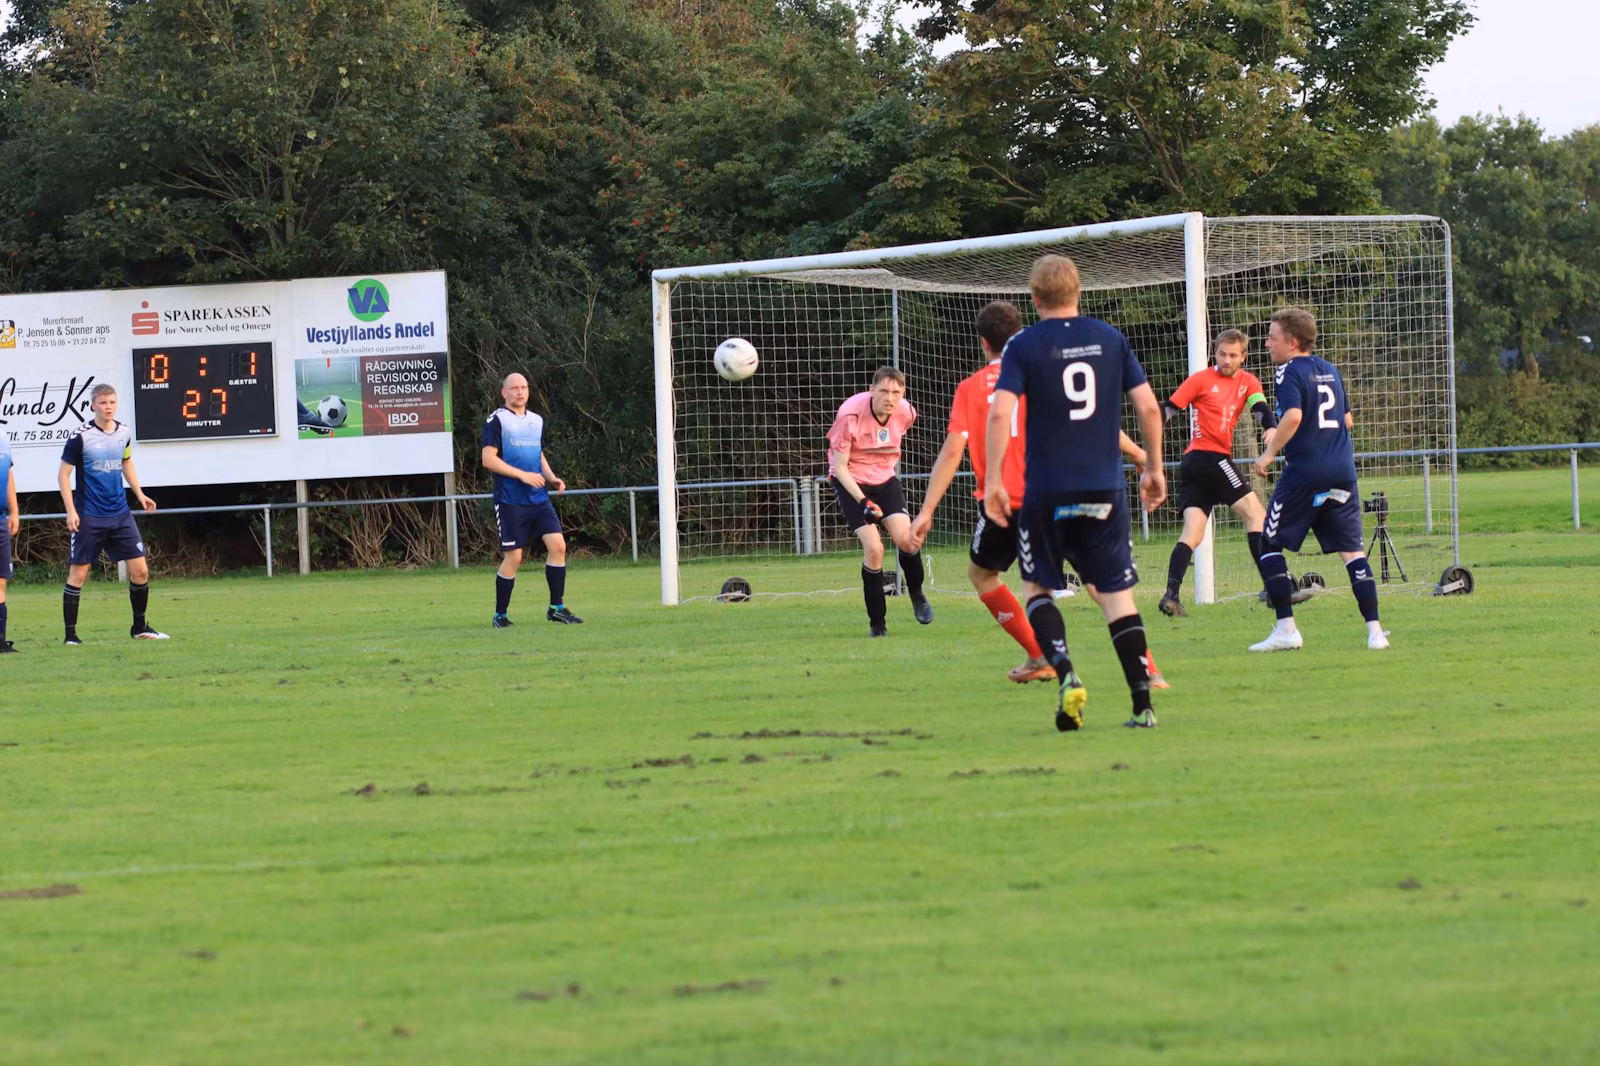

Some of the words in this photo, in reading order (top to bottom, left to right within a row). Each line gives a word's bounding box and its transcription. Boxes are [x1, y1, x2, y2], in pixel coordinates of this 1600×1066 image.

[347, 286, 390, 314] VA
[164, 305, 272, 322] SPAREKASSEN
[42, 316, 84, 325] Murerfirmaet
[18, 328, 24, 338] P.
[26, 328, 55, 337] Jensen
[56, 327, 63, 336] &
[65, 326, 93, 335] Sønner
[96, 325, 110, 336] aps
[165, 327, 177, 335] for
[180, 325, 203, 334] Nørre
[205, 324, 228, 333] Nebel
[242, 322, 271, 331] Omegn
[306, 324, 392, 345] Vestjyllands
[395, 321, 435, 339] Andel
[50, 339, 57, 347] 15
[351, 346, 374, 354] kvalitet
[386, 343, 425, 352] partnerskab!
[151, 354, 168, 382] 0
[250, 352, 256, 376] 1
[366, 359, 437, 372] RÅDGIVNING,
[367, 372, 418, 384] REVISION
[421, 371, 438, 381] OG
[374, 383, 433, 395] REGNSKAB
[1063, 361, 1096, 420] 9
[38, 376, 95, 426] Kr
[183, 389, 227, 418] 27
[1317, 385, 1339, 429] 2
[391, 413, 418, 424] BDO
[6, 431, 20, 441] lf.
[24, 431, 37, 441] 75
[40, 430, 53, 440] 28
[56, 429, 70, 439] 20
